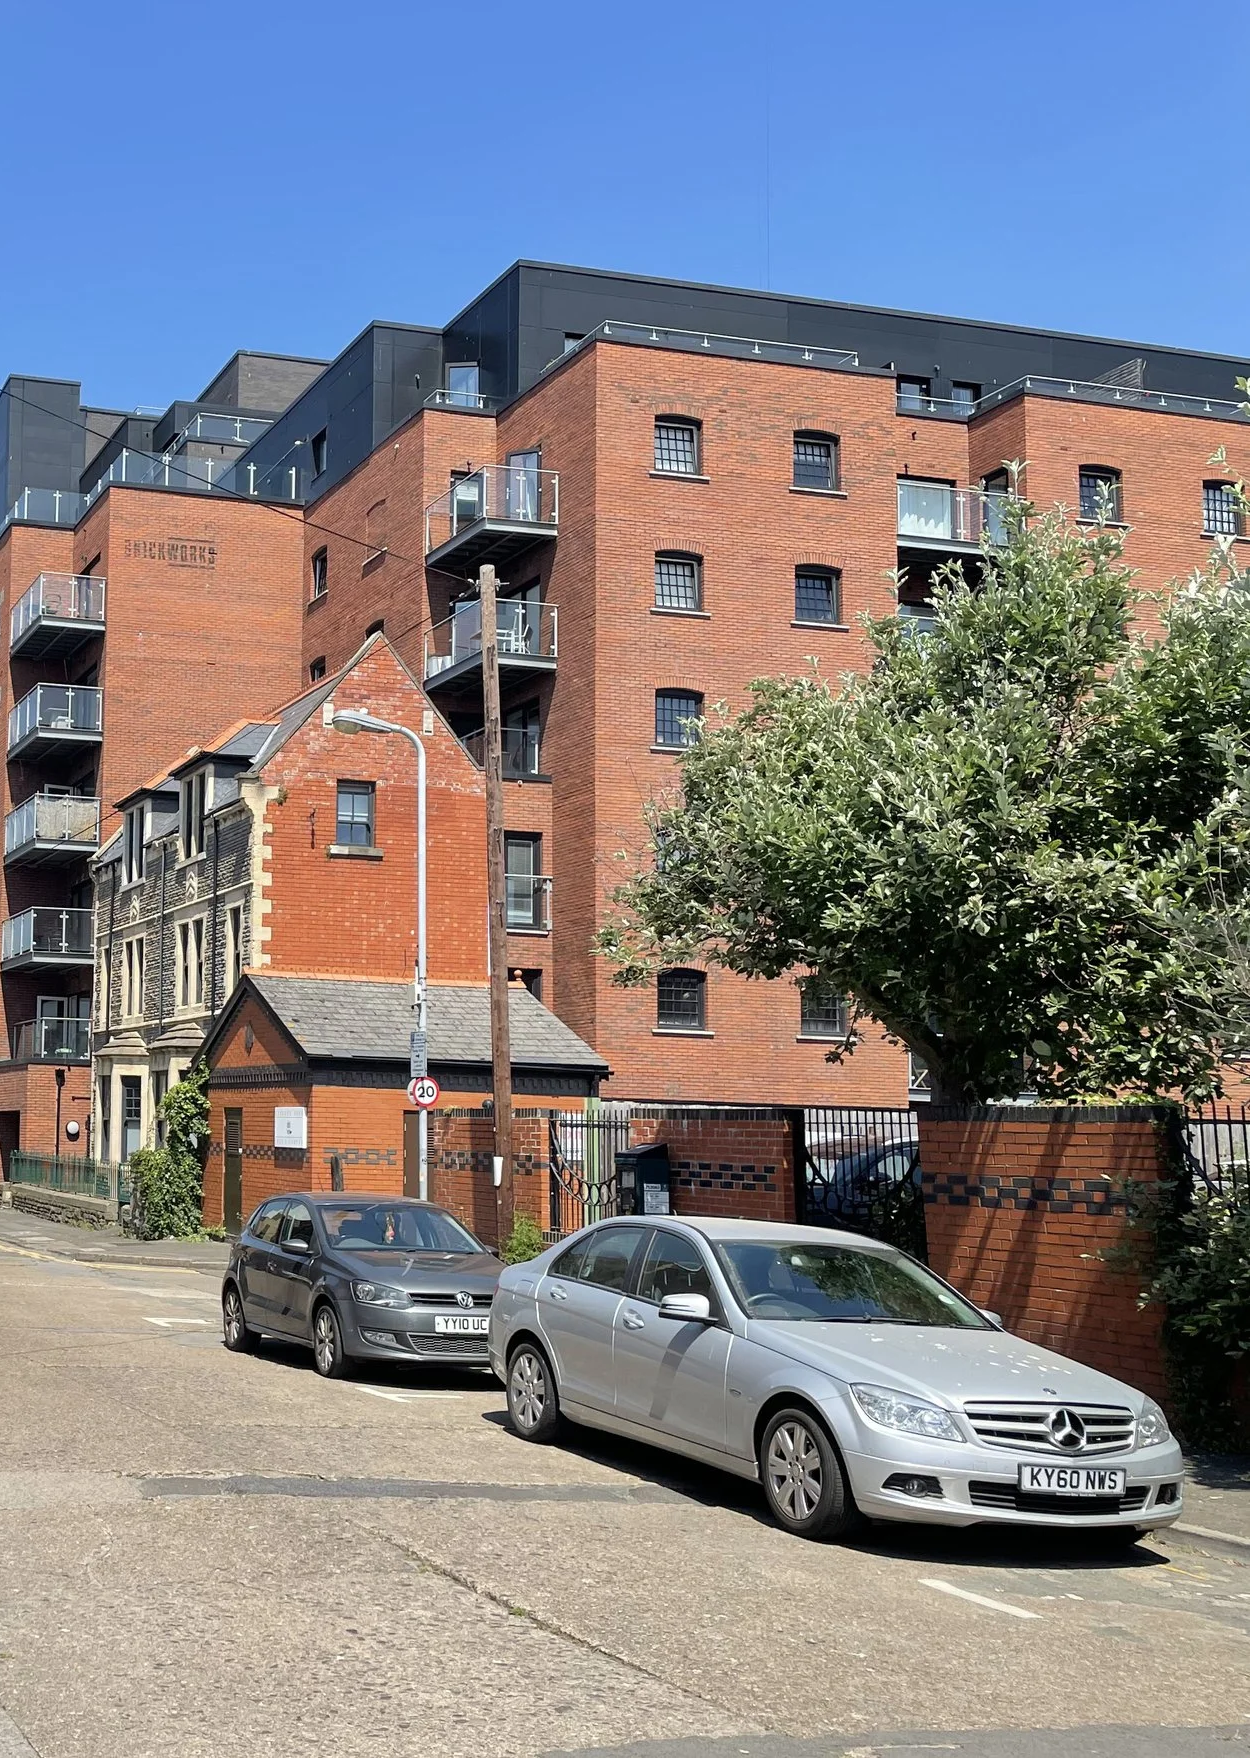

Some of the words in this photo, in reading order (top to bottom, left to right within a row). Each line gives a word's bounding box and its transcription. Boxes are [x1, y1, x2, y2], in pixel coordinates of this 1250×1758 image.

[124, 539, 216, 565] BRICKWORKS
[417, 1085, 435, 1098] 20
[442, 1317, 469, 1330] YY10
[472, 1318, 488, 1331] UC
[1030, 1467, 1080, 1489] KY60
[1086, 1470, 1118, 1490] NWS
